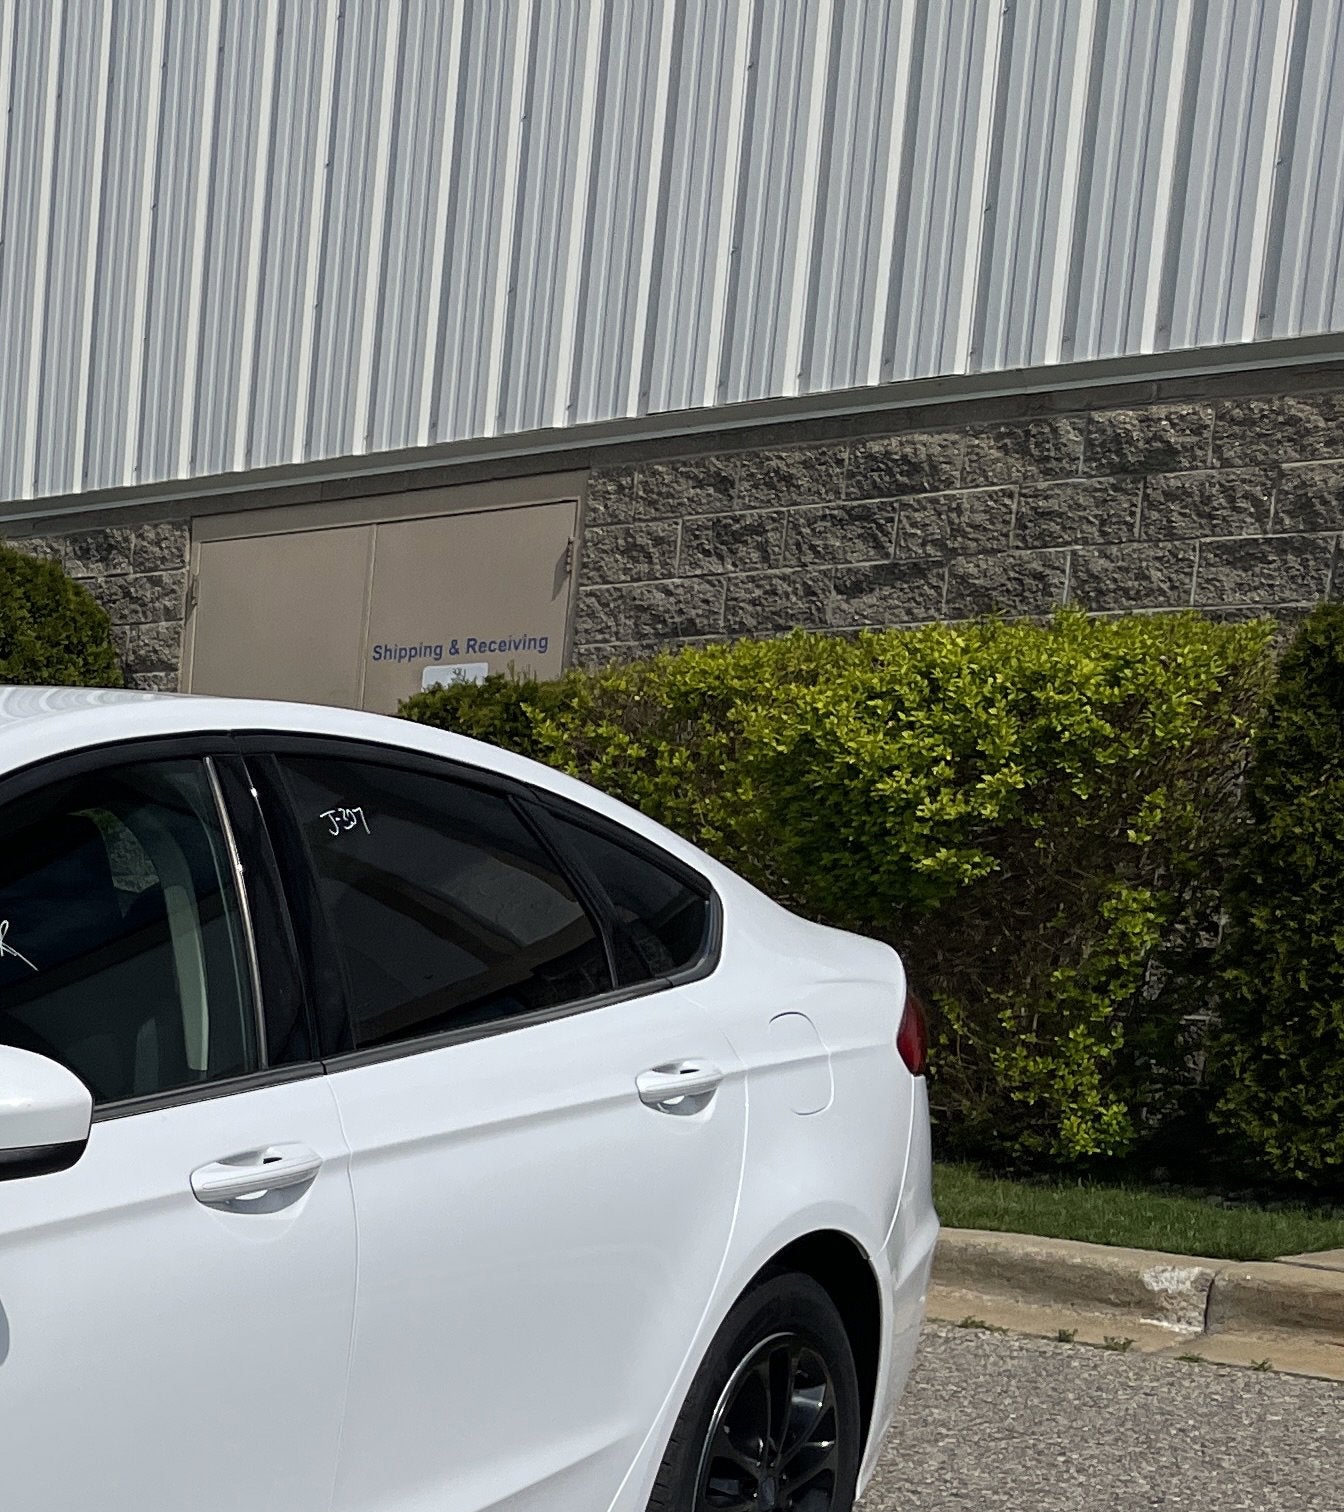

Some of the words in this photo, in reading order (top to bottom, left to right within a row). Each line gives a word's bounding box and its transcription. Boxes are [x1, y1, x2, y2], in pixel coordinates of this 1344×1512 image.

[372, 641, 443, 663] Shipping
[448, 639, 460, 656] &
[465, 633, 549, 655] Receiving
